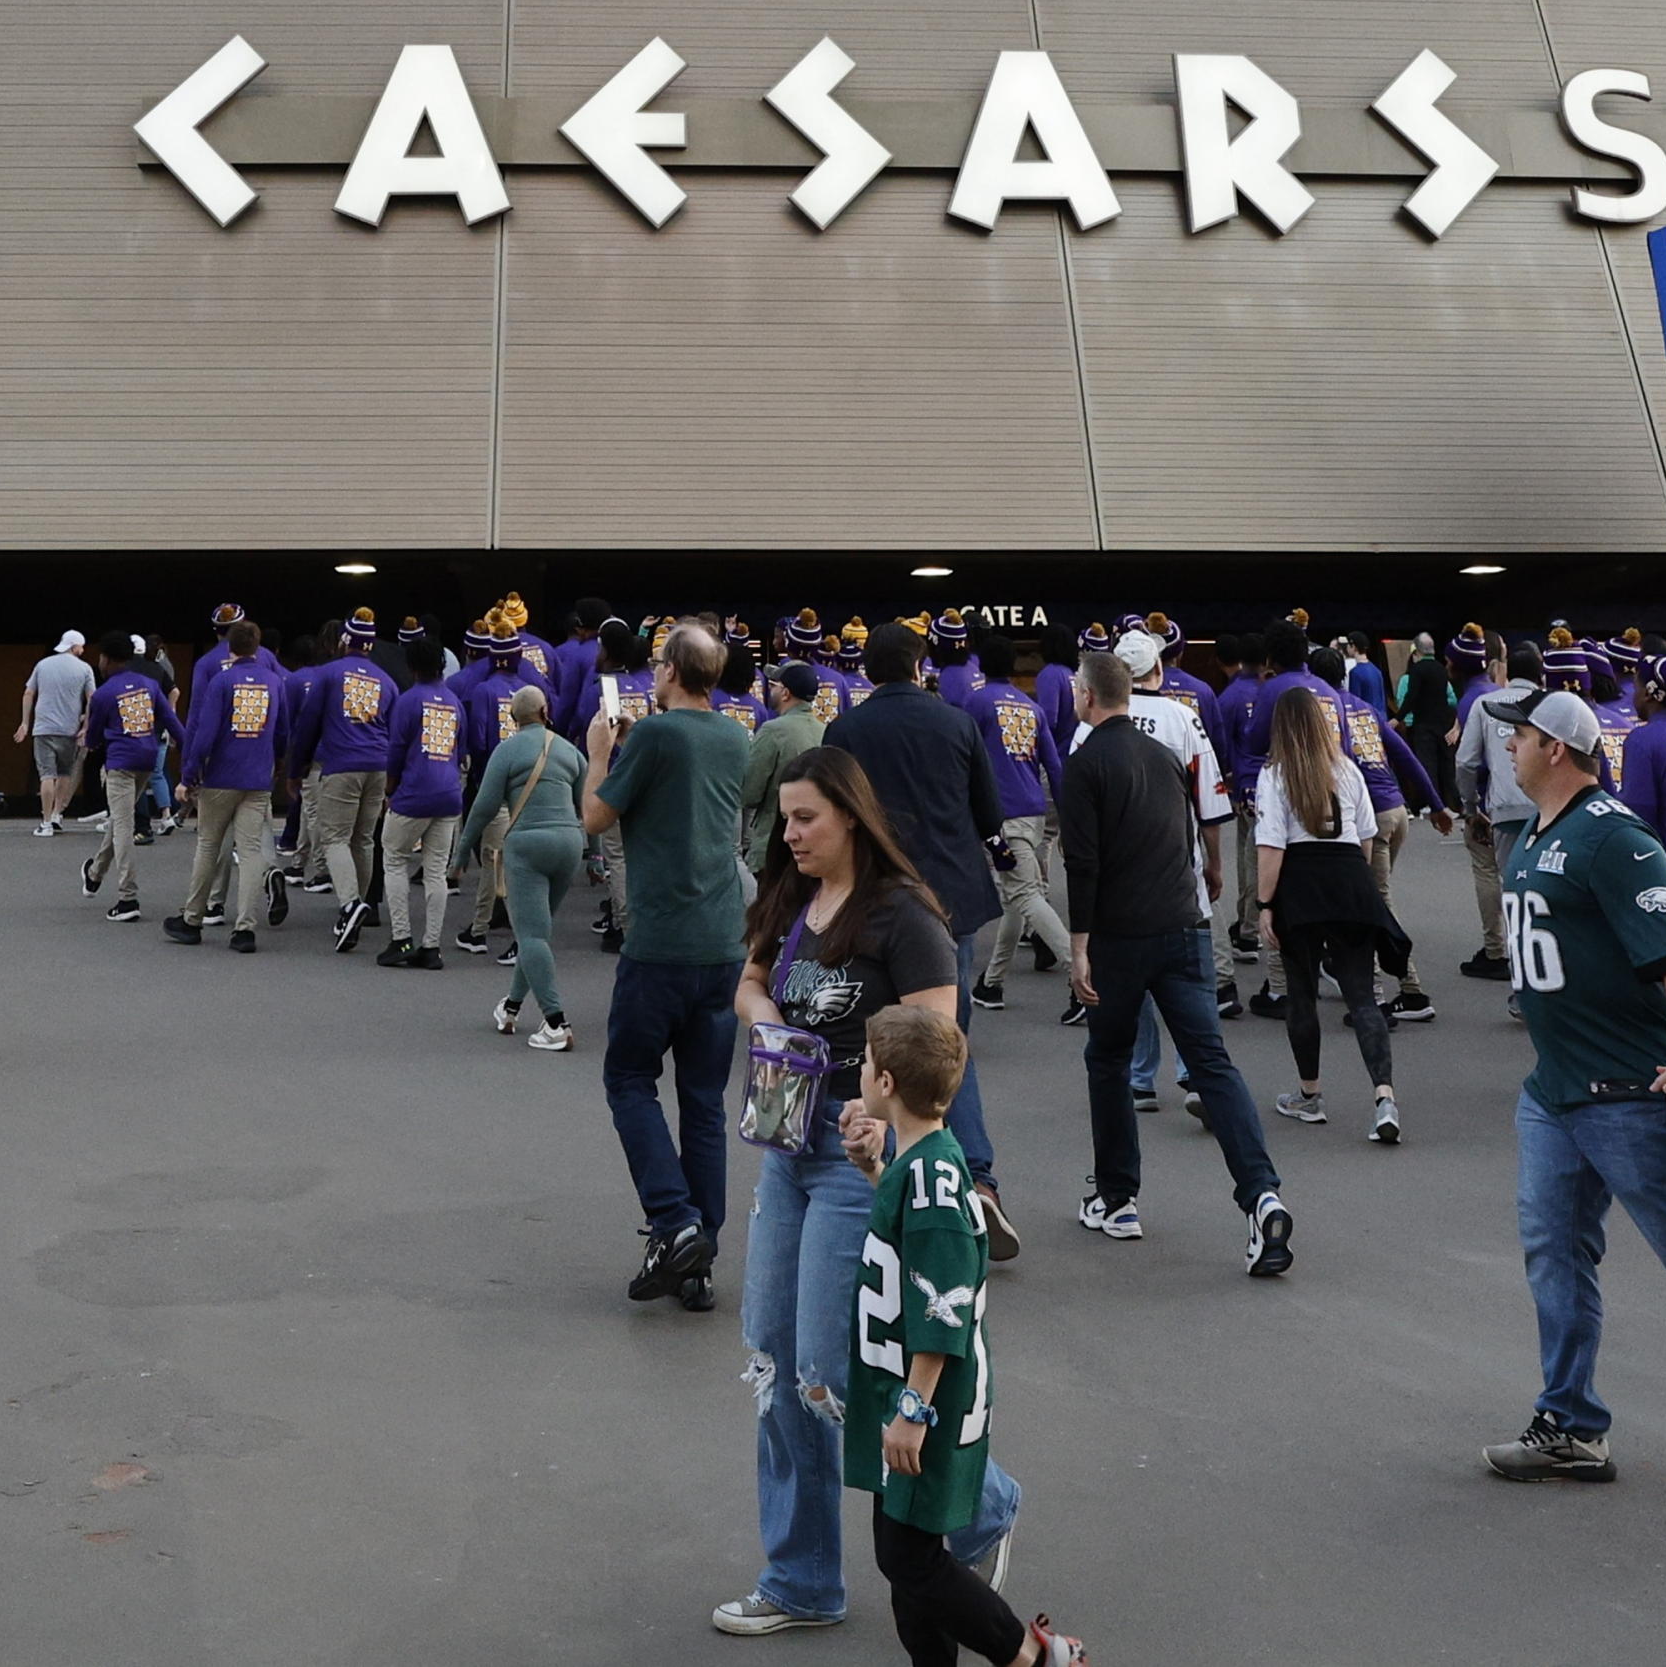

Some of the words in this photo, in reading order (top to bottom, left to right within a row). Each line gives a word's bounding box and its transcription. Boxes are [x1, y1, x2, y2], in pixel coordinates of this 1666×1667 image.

[132, 33, 1501, 242] CAESARS
[1031, 606, 1048, 626] A
[1502, 890, 1565, 993] 86
[909, 1158, 960, 1210] 12
